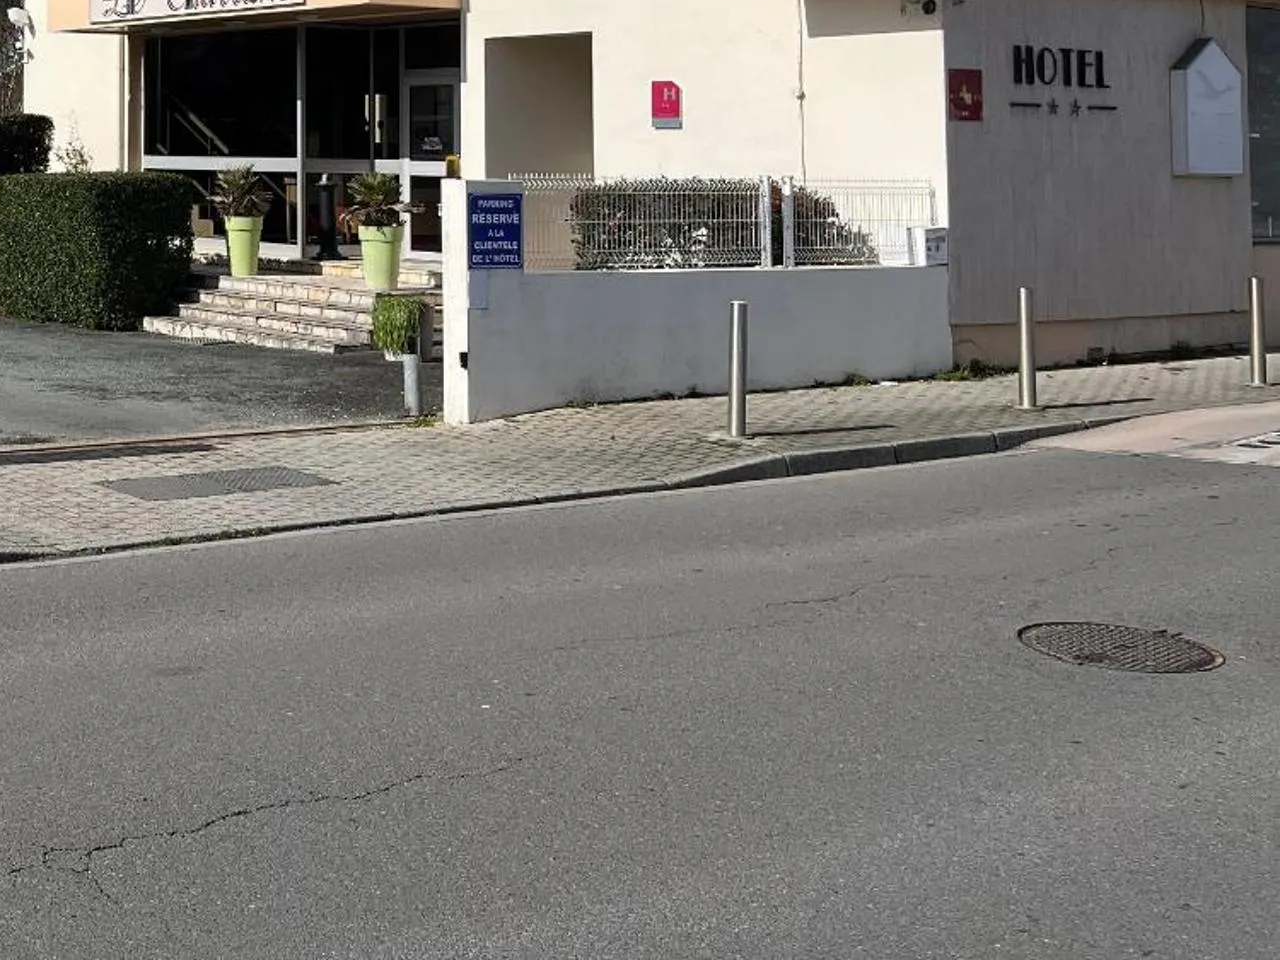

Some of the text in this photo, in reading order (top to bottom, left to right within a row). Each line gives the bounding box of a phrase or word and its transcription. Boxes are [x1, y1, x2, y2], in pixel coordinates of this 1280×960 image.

[1013, 45, 1110, 89] HOTEL
[494, 229, 505, 238] LA
[472, 254, 484, 263] DE
